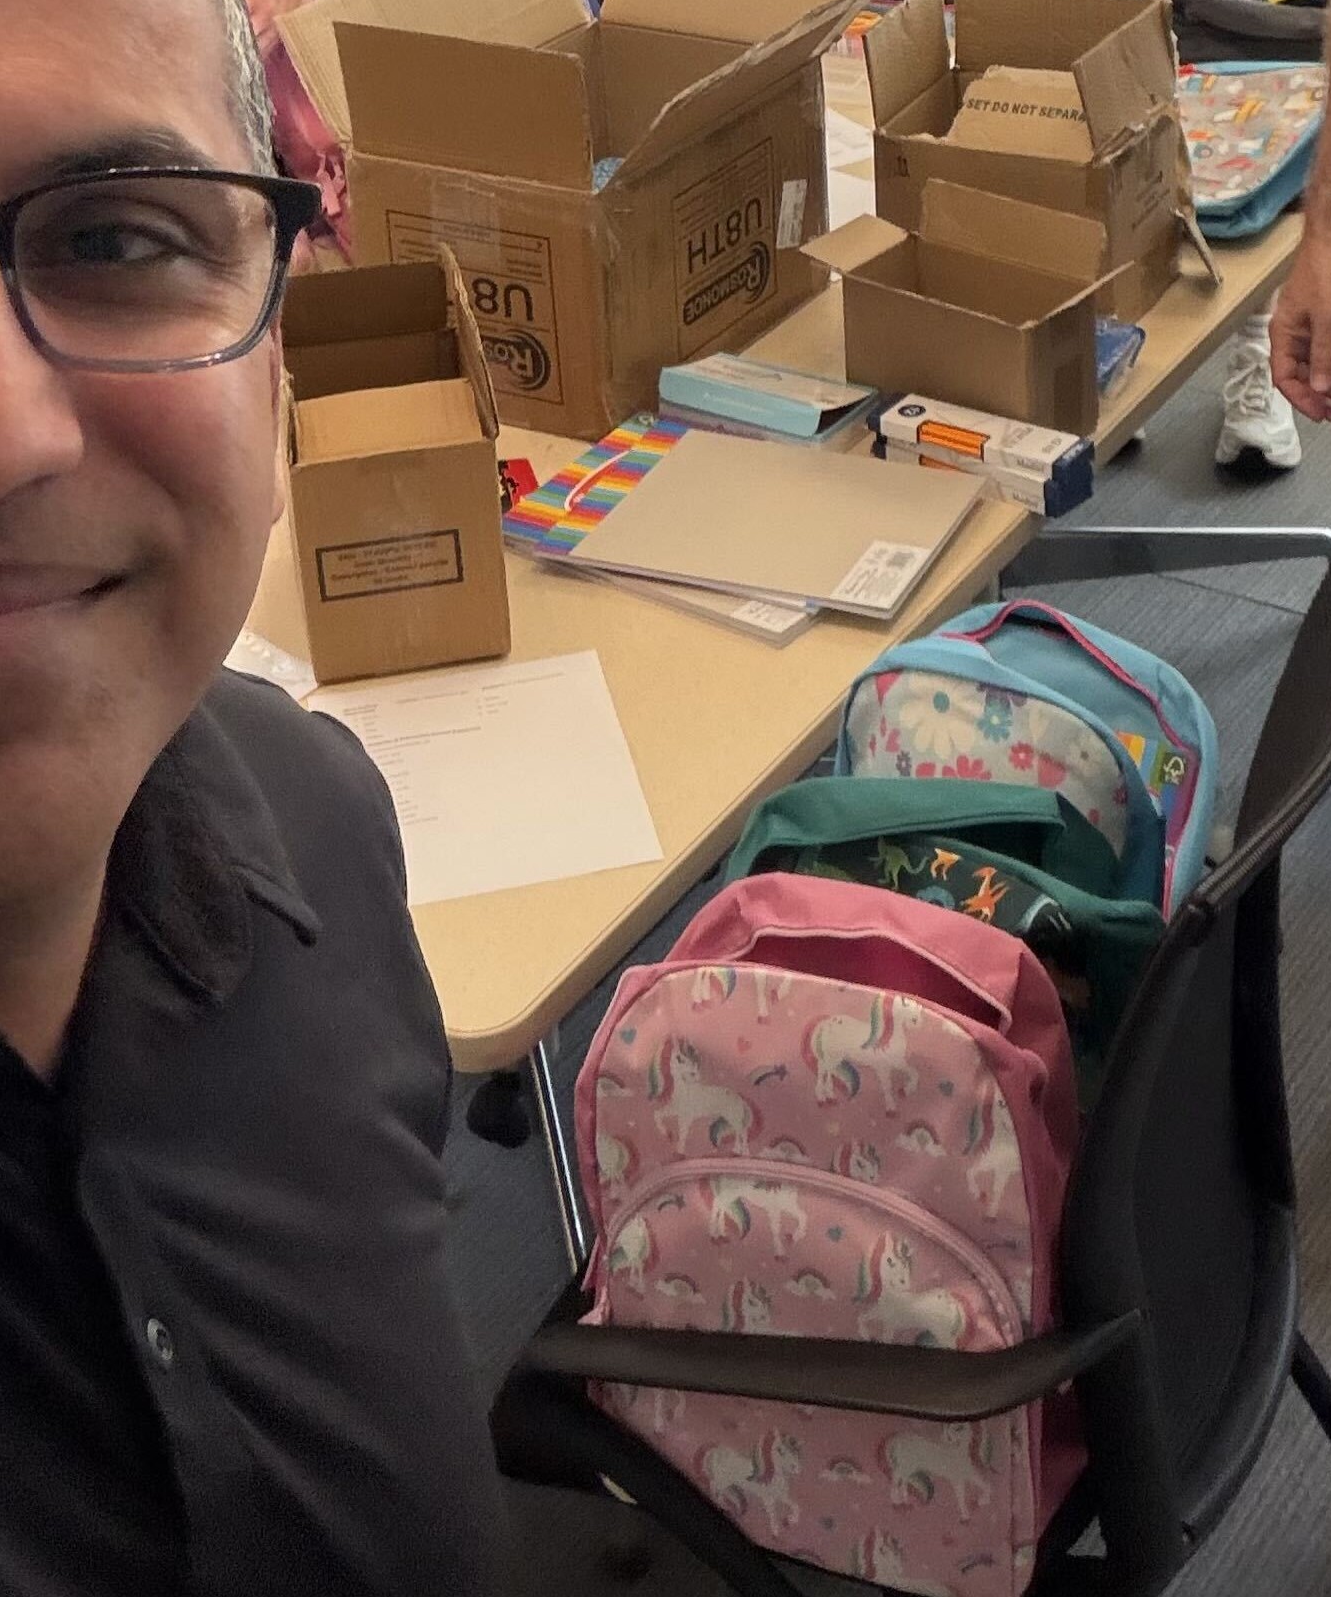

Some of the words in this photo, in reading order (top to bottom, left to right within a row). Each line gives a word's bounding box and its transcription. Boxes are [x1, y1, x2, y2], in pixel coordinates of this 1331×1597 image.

[966, 98, 990, 111] SET
[992, 100, 1009, 113] DO
[1012, 102, 1037, 116] NOT
[687, 197, 762, 274] U8TH
[471, 278, 534, 322] U8
